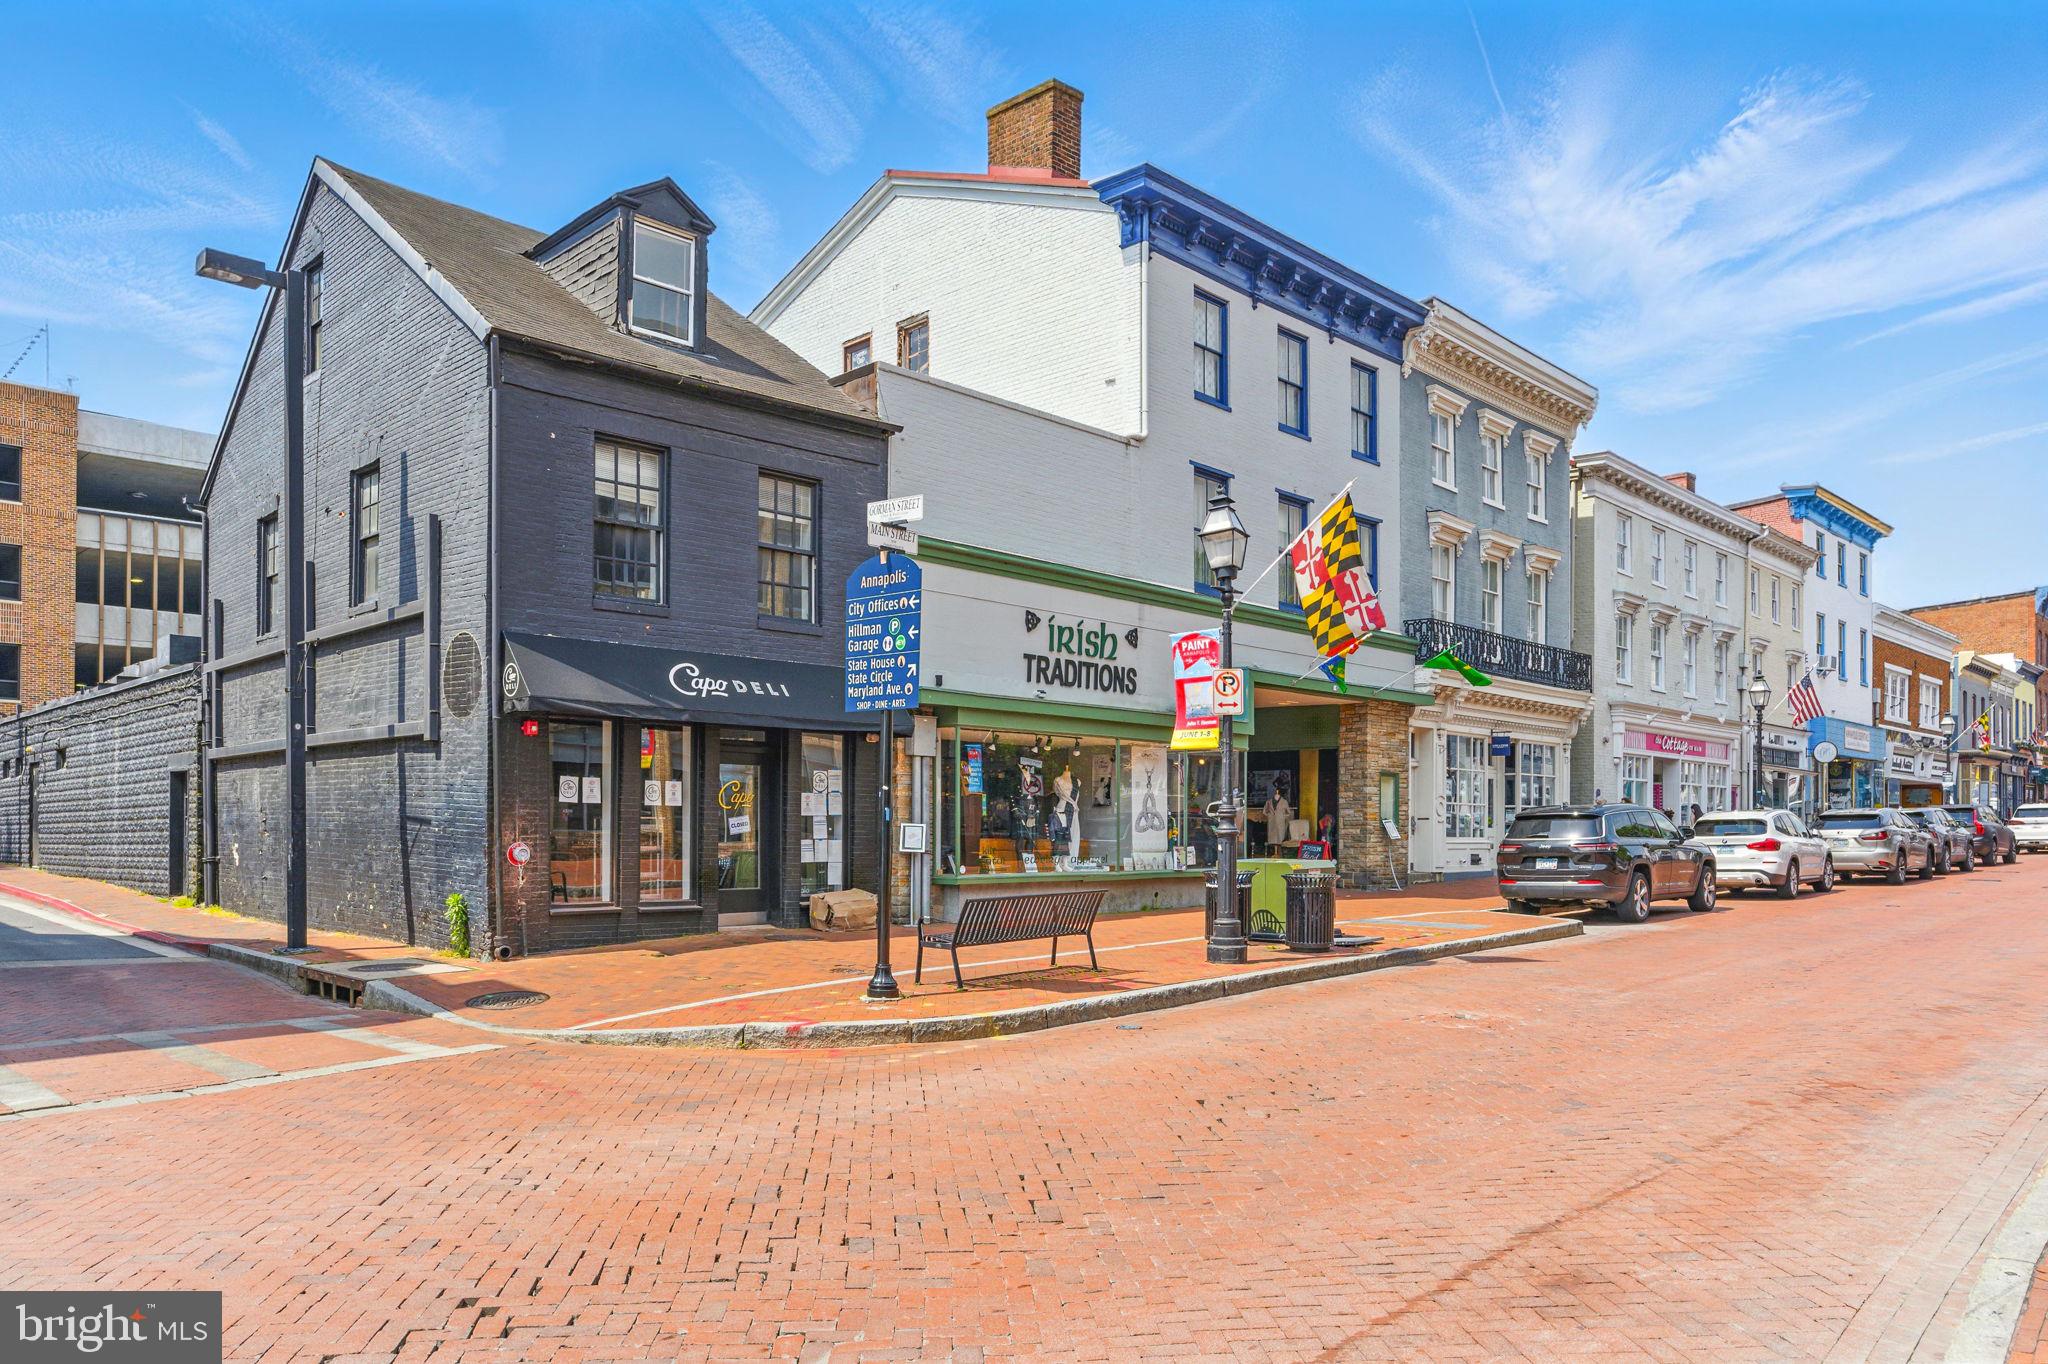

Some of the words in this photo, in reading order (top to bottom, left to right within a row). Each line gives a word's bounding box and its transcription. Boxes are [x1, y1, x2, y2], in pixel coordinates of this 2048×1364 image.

[869, 503, 896, 516] GORMAN
[897, 498, 920, 511] STREET
[871, 523, 889, 537] MAIN
[890, 526, 916, 543] STREET
[861, 570, 907, 588] Annapolis
[848, 602, 864, 617] City
[868, 599, 899, 613] Offices
[848, 624, 881, 637] Hillman
[848, 639, 879, 653] Garage
[1181, 640, 1210, 651] PAINT
[848, 659, 867, 671] State
[870, 657, 895, 669] House
[668, 662, 729, 697] Capo
[731, 679, 790, 697] DELI
[848, 673, 867, 685] State
[870, 670, 893, 682] Circle
[1023, 653, 1138, 695] TRADITIONS
[848, 684, 883, 699] Maryland
[886, 684, 903, 695] Ave.
[857, 701, 871, 710] SHOP
[891, 698, 906, 707] ARTS
[1661, 735, 1689, 756] Cottage
[718, 780, 755, 810] Capo
